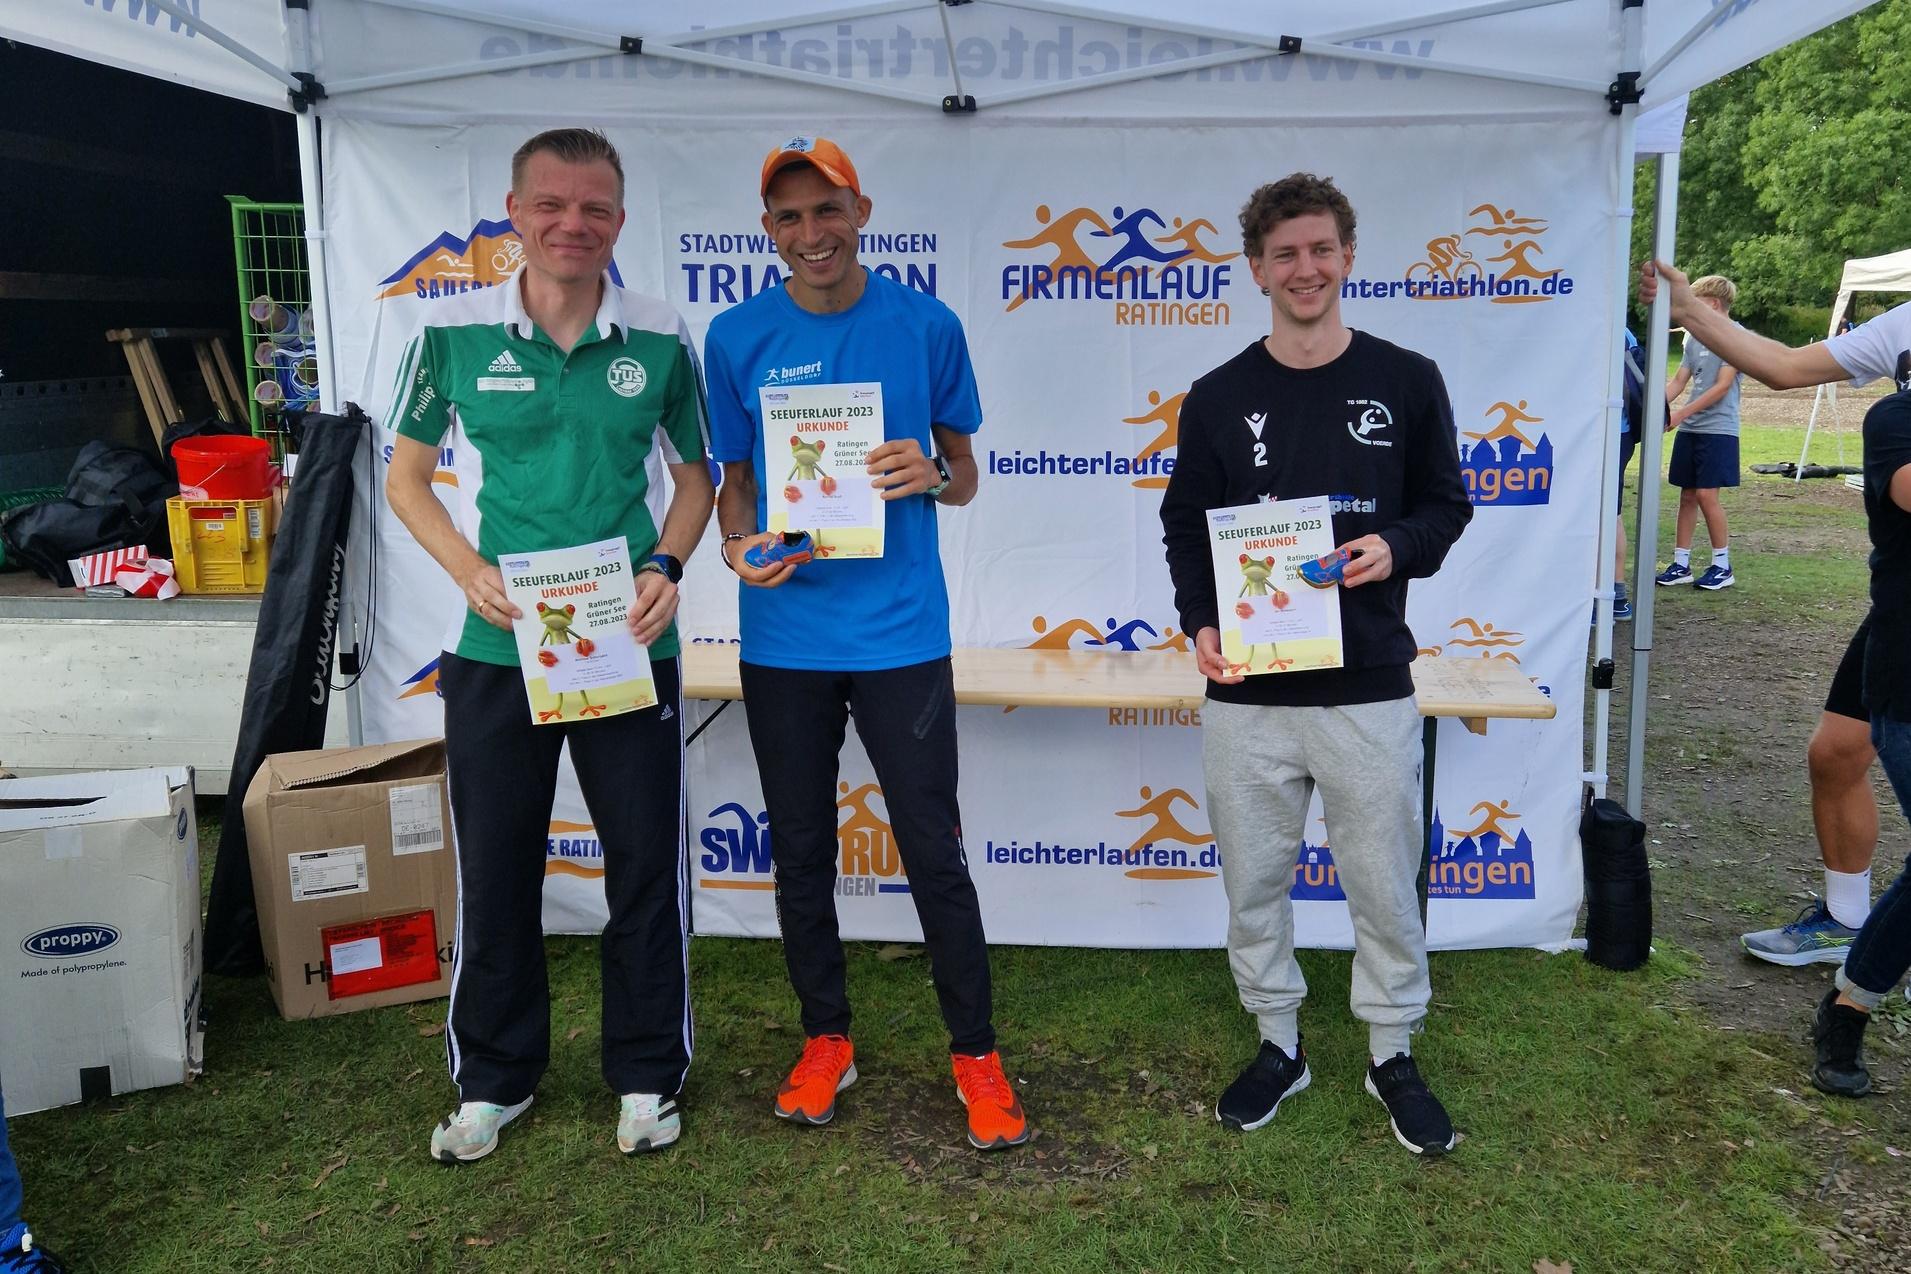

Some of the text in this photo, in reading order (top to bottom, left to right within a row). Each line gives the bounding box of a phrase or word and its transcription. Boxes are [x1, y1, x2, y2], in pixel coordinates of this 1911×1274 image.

[680, 234, 937, 253] STADTWE TINGEN
[1002, 265, 1231, 299] FIRMENLAUF
[1342, 273, 1574, 299] htertriathlon.de
[1115, 303, 1230, 325] RATINGEN
[488, 364, 522, 372] adidas
[781, 361, 822, 379] bunert
[770, 406, 873, 420] SEEUFERLAUF 2023
[797, 421, 849, 432] URKUNDE
[837, 441, 869, 449] Ratingen
[989, 451, 1177, 475] leichterlaufe
[1253, 442, 1268, 467] 2
[1461, 467, 1549, 501] ngen
[1328, 498, 1376, 515] petal
[1218, 519, 1322, 541] SEEUFERLAUF 2023
[1244, 535, 1298, 550] URKUNDE
[512, 561, 622, 588] SEEUFERLAUF 2023
[541, 581, 599, 599] URKUNDE
[586, 604, 627, 619] Grüner See
[588, 597, 622, 610] Ratingen
[589, 614, 628, 628] 27.08.2023
[1109, 707, 1202, 726] RATINGE
[560, 839, 602, 857] RATI
[986, 841, 1222, 868] leichterlaufen.d
[1430, 855, 1531, 894] ingen
[40, 931, 103, 950] proppy
[20, 960, 127, 978] Made of polypropylene.
